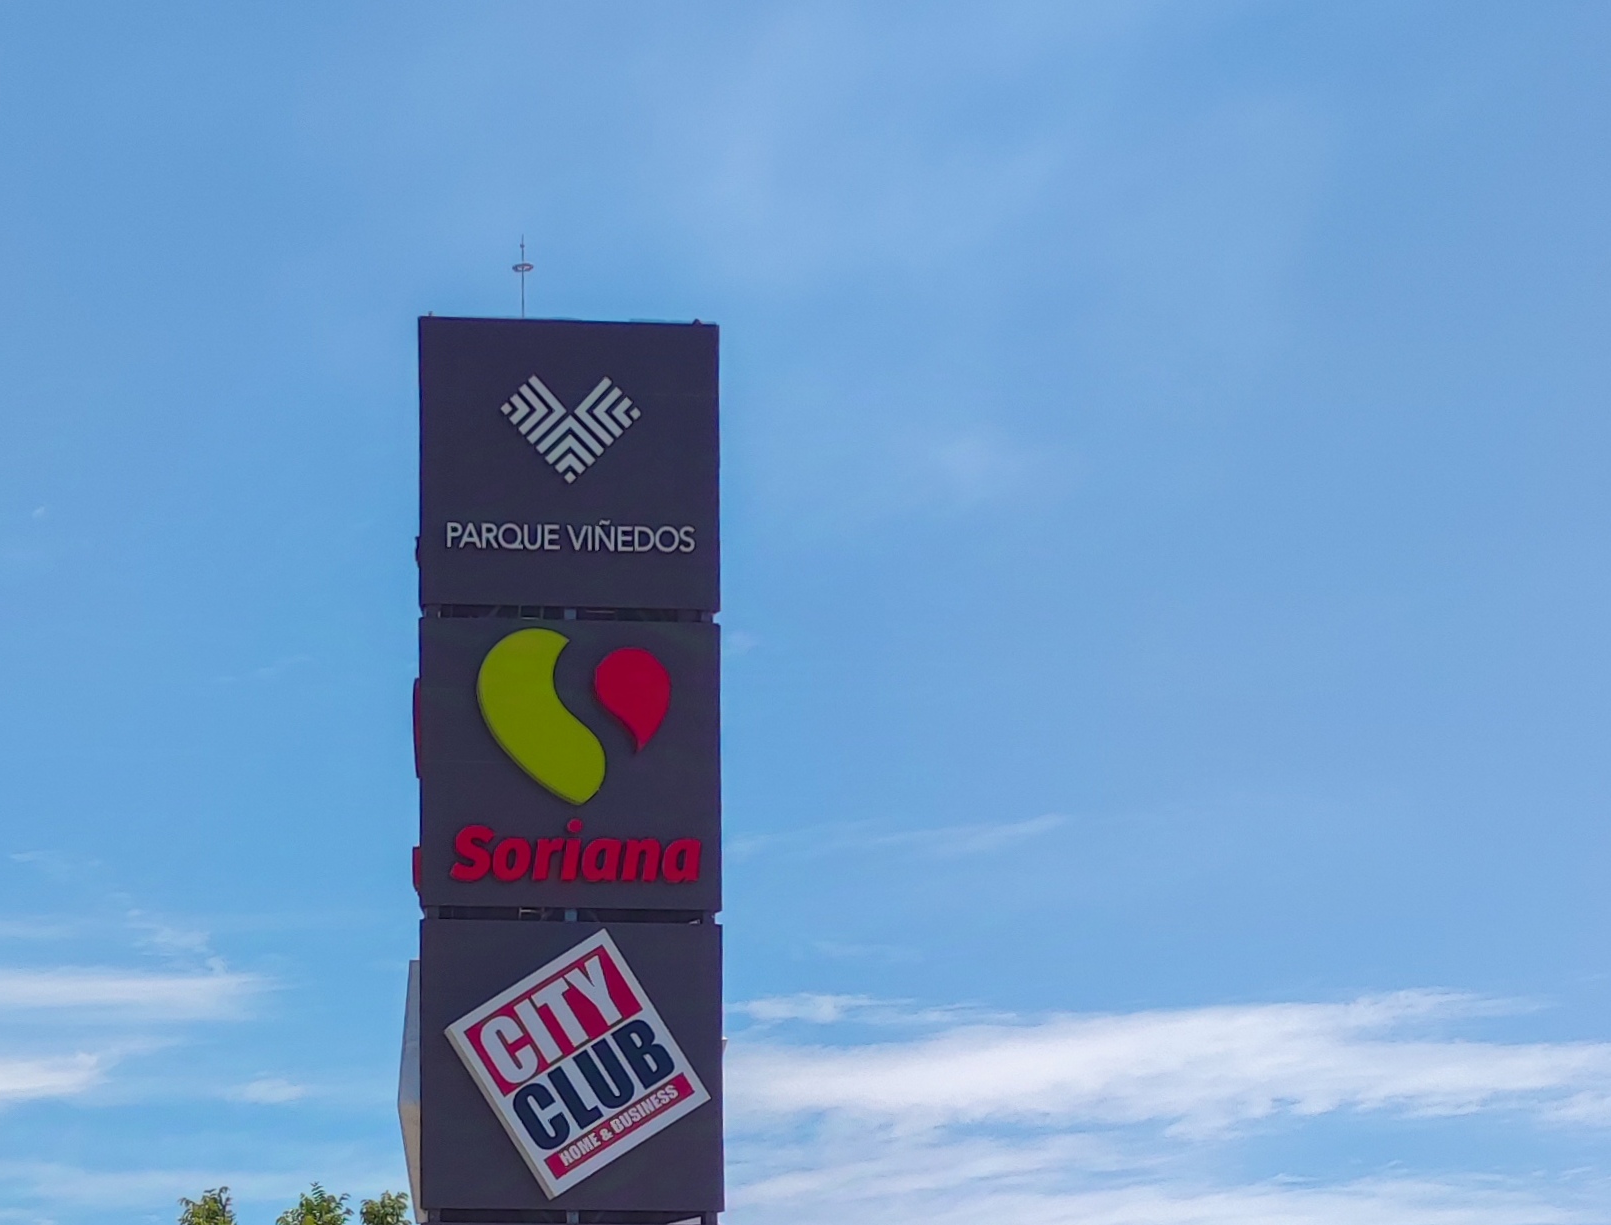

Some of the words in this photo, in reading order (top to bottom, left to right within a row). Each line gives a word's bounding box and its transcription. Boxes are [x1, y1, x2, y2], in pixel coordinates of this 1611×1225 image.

[446, 522, 561, 551] PARQUE
[567, 518, 696, 553] VIÑEDOS
[449, 818, 702, 884] Soriana
[479, 954, 624, 1084] CITY
[512, 1018, 676, 1151] CLUB
[559, 1132, 601, 1167] HOME
[599, 1126, 614, 1142] &
[609, 1083, 680, 1135] BUSINESS
